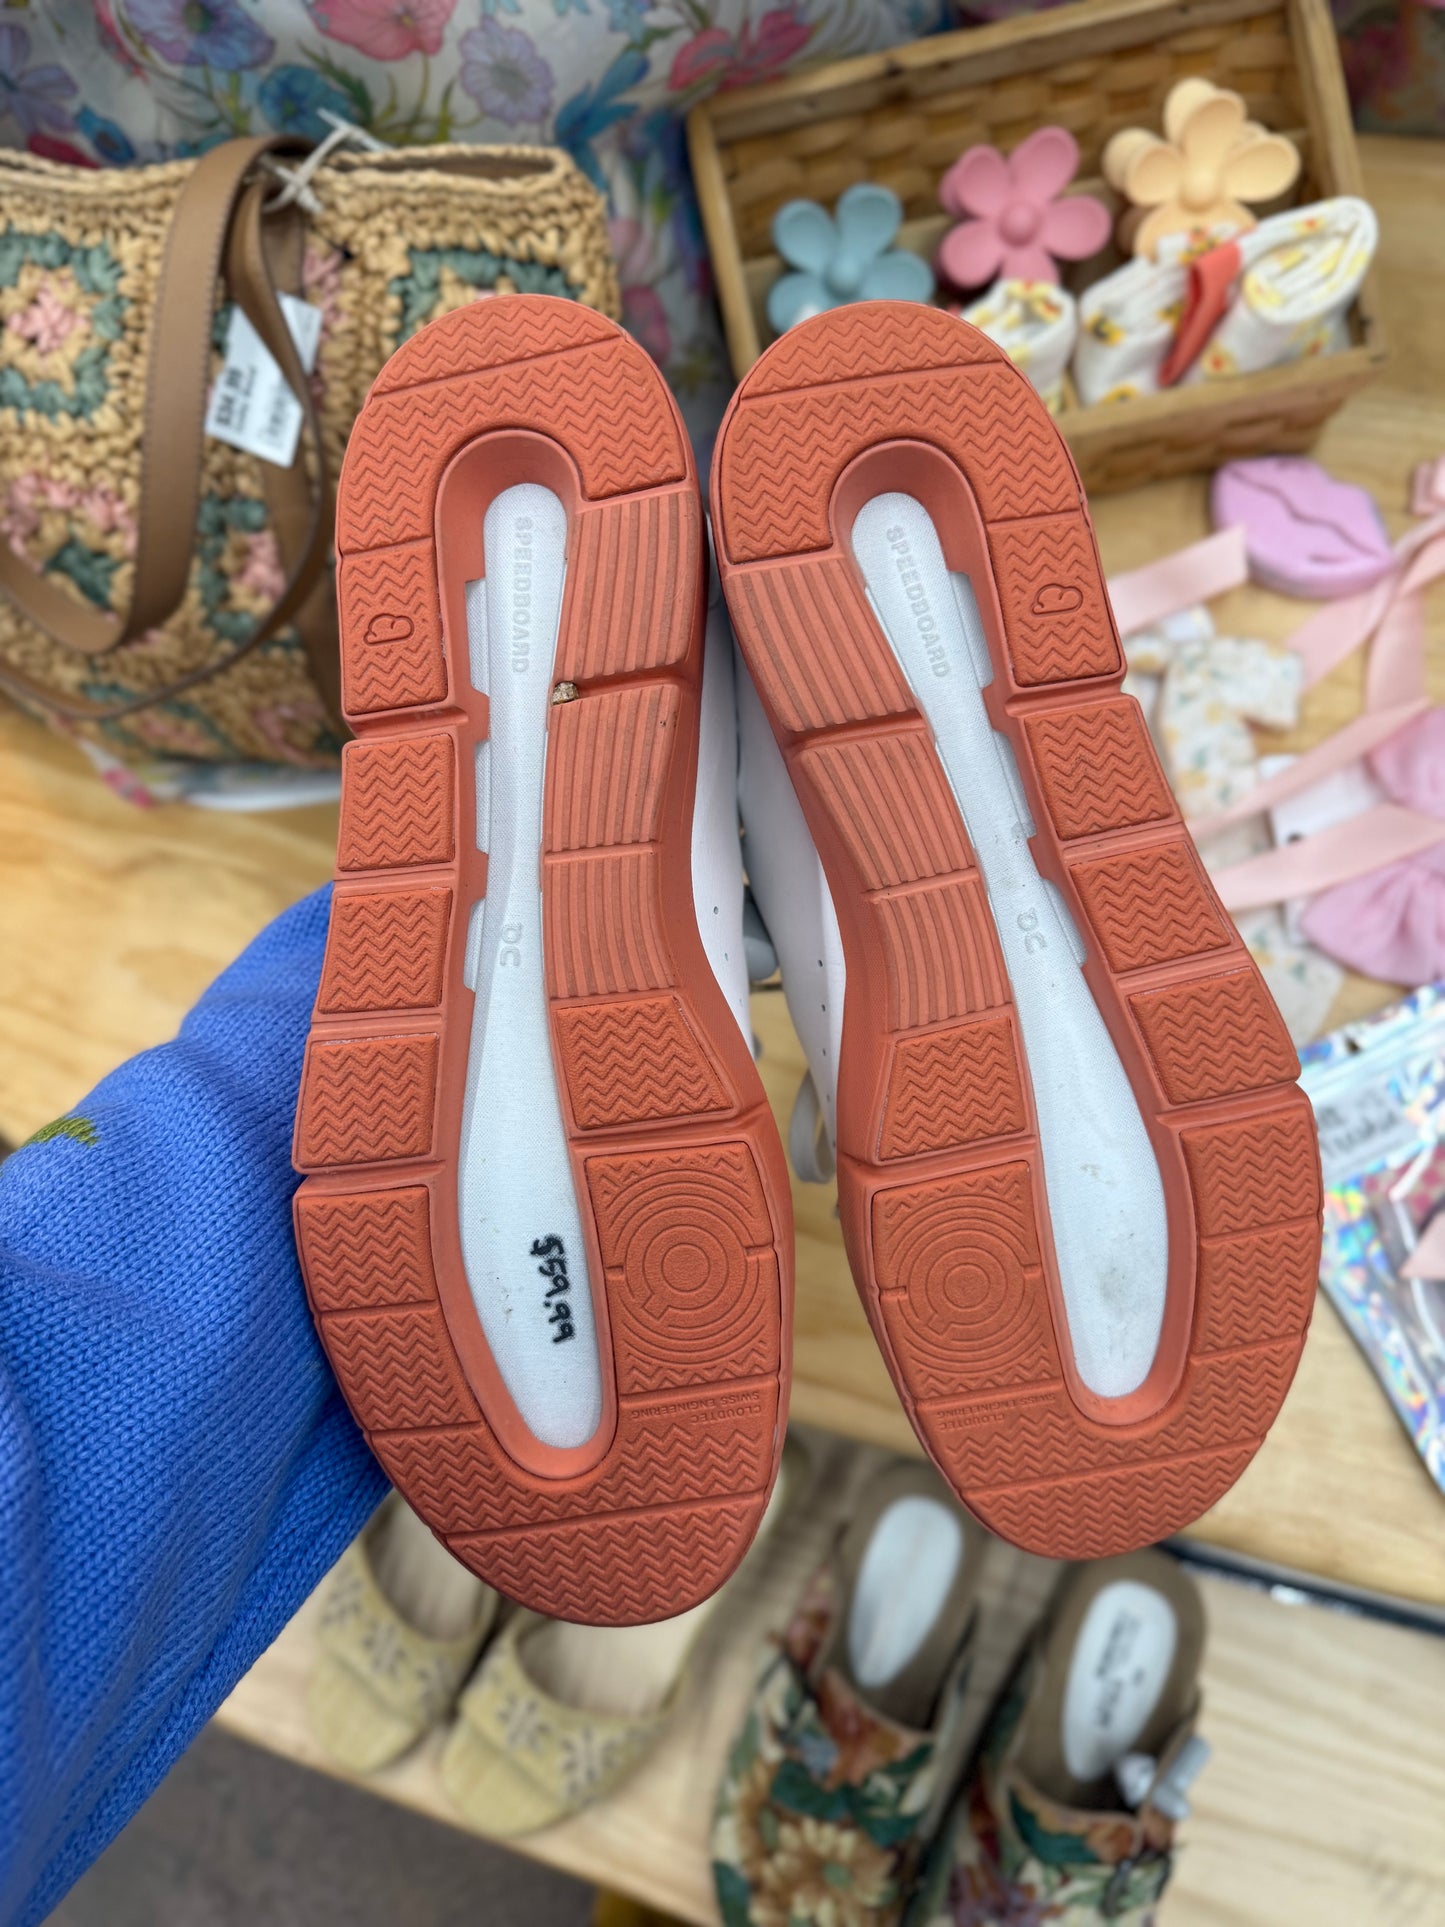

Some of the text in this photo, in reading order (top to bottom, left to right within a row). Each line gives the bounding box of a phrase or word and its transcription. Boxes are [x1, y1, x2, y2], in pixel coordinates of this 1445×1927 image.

[512, 516, 534, 673] SPEEDBOARD
[886, 524, 950, 678] SPEEDBOARD
[530, 1234, 575, 1343] $59.99
[631, 1391, 760, 1419] SWISS ENGINEERING
[1021, 1392, 1056, 1406] SWISS
[691, 1404, 762, 1424] CLOUDTEC
[939, 1413, 1005, 1431] CLOUDTEC
